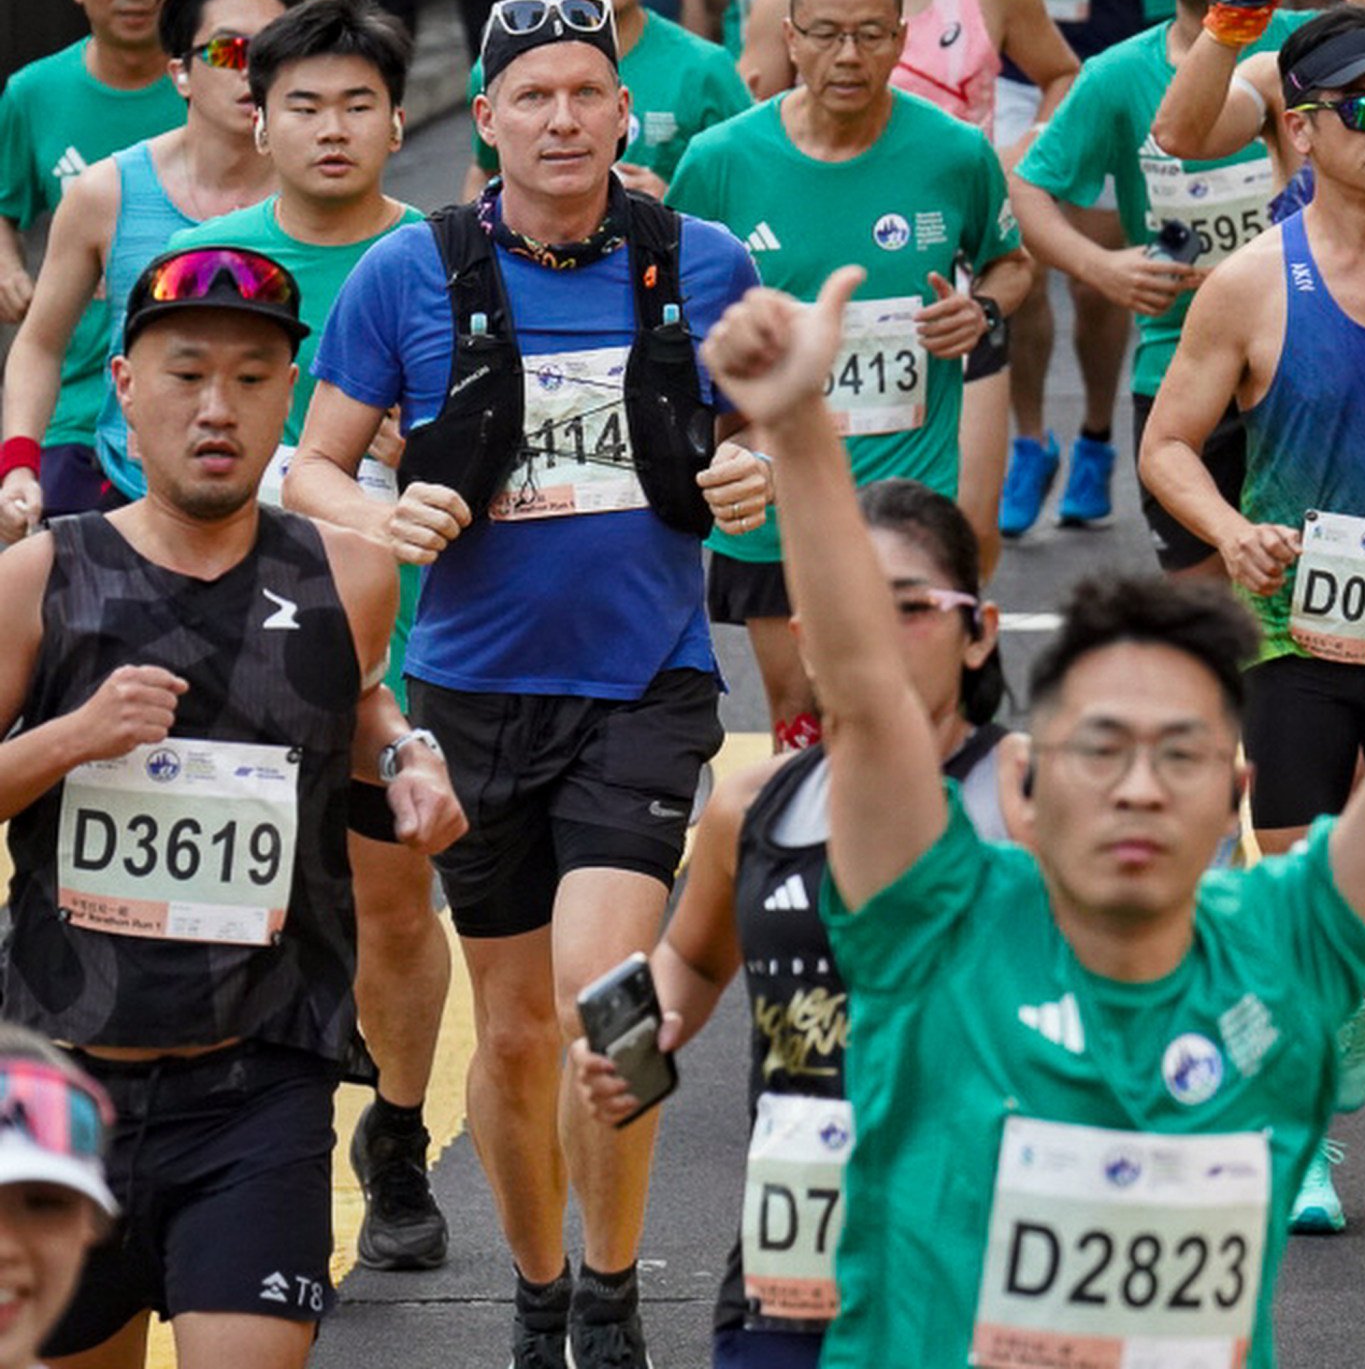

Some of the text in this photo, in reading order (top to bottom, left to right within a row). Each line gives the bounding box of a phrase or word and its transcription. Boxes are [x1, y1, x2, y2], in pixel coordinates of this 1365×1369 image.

[826, 349, 919, 397] 413
[73, 809, 283, 886] D3619
[295, 1275, 323, 1311] T8
[1006, 1220, 1246, 1309] D2823
